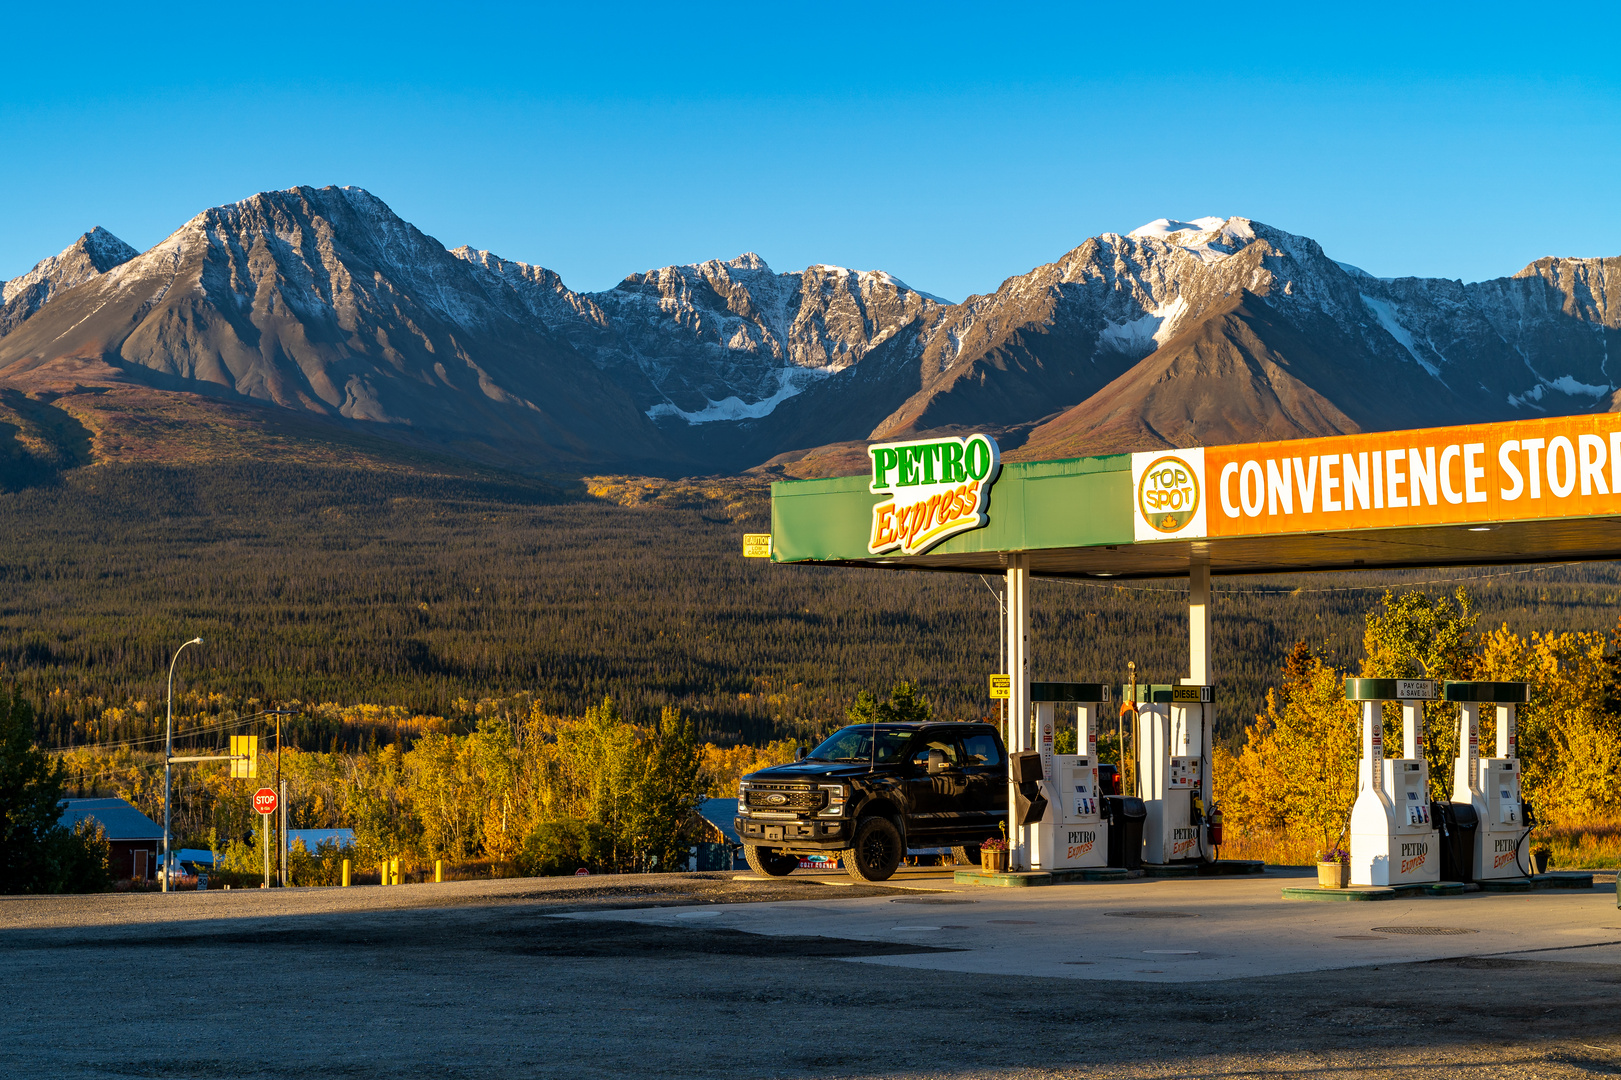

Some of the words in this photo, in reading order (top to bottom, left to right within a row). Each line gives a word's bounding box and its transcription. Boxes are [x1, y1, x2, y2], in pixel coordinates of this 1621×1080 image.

[871, 438, 991, 489] PETRO
[1150, 468, 1187, 490] TOP
[1219, 442, 1488, 518] CONVENIENCE
[1146, 487, 1192, 511] SPOT
[871, 480, 979, 549] Express
[745, 536, 769, 545] CAUTION
[1174, 689, 1199, 699] DIESEL
[1202, 687, 1209, 701] 11
[256, 795, 274, 804] STOP
[1068, 831, 1096, 844] PETRO
[1173, 828, 1198, 840] PETRO
[1067, 840, 1094, 859] Express
[1173, 837, 1197, 855] Express
[1401, 842, 1428, 857] PETRO
[1493, 839, 1519, 852] PETRO
[1400, 852, 1426, 874] Express
[1493, 849, 1516, 869] Express
[199, 878, 207, 886] 50
